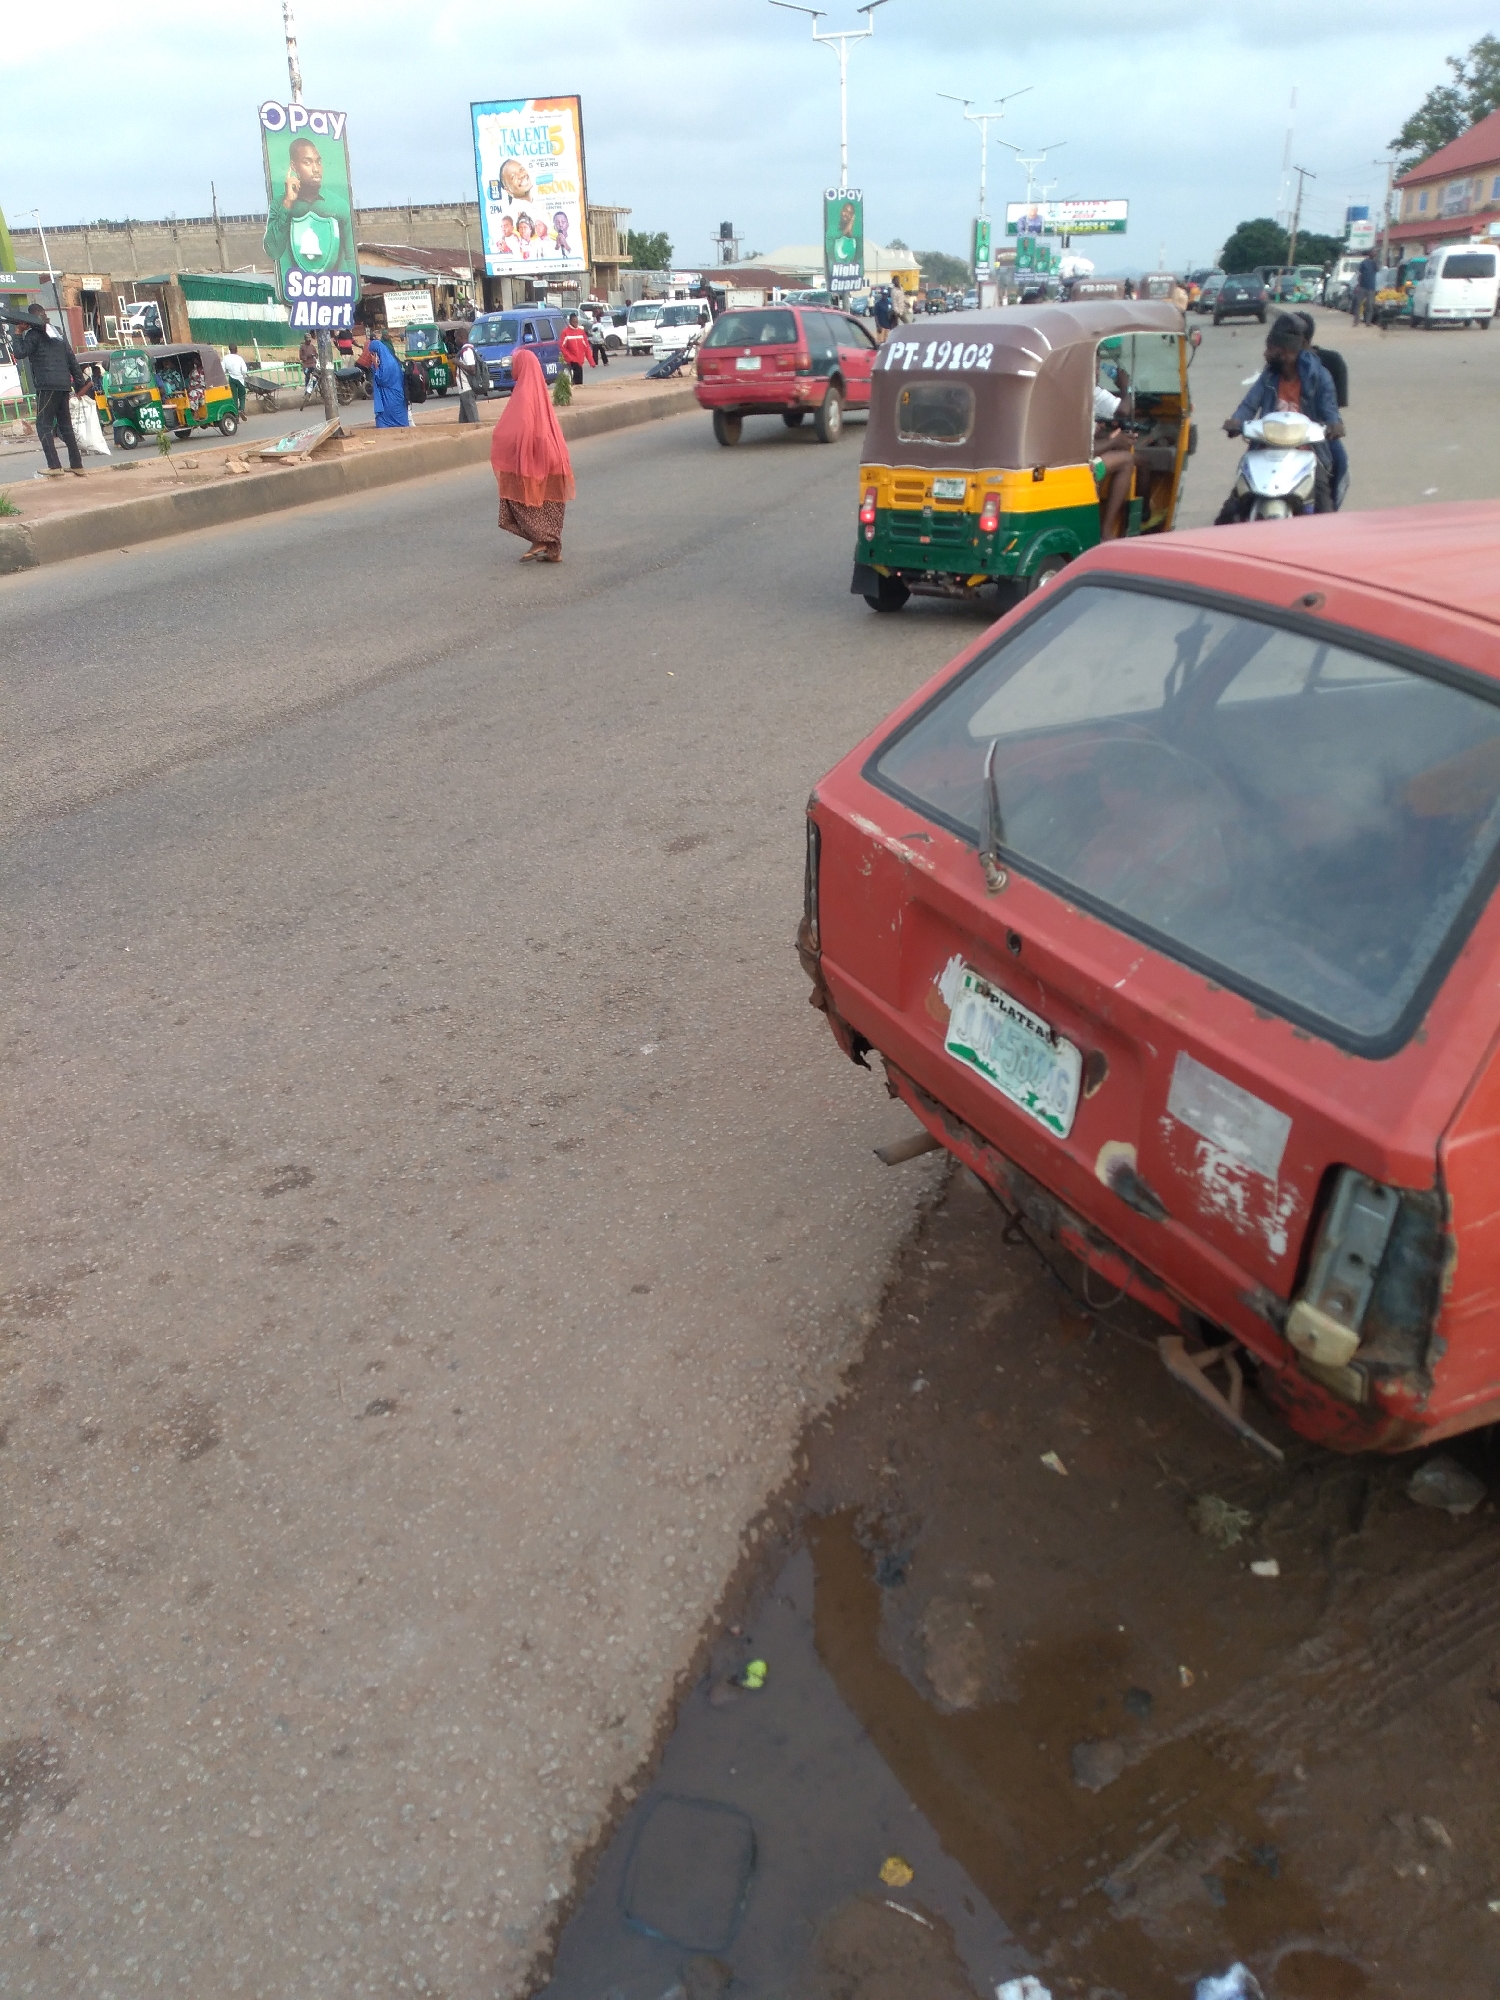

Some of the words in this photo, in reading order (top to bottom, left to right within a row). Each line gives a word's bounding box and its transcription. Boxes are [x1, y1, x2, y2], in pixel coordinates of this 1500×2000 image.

[260, 101, 346, 139] OPay
[500, 125, 549, 142] TALENT
[548, 125, 565, 156] 5
[499, 141, 554, 157] UNCAGED
[825, 187, 863, 202] OPay
[490, 205, 503, 215] 2PM
[832, 264, 860, 277] Night
[288, 272, 352, 297] Scam
[831, 278, 862, 291] Guard
[294, 301, 353, 326] Alert
[884, 340, 994, 370] PT-19102
